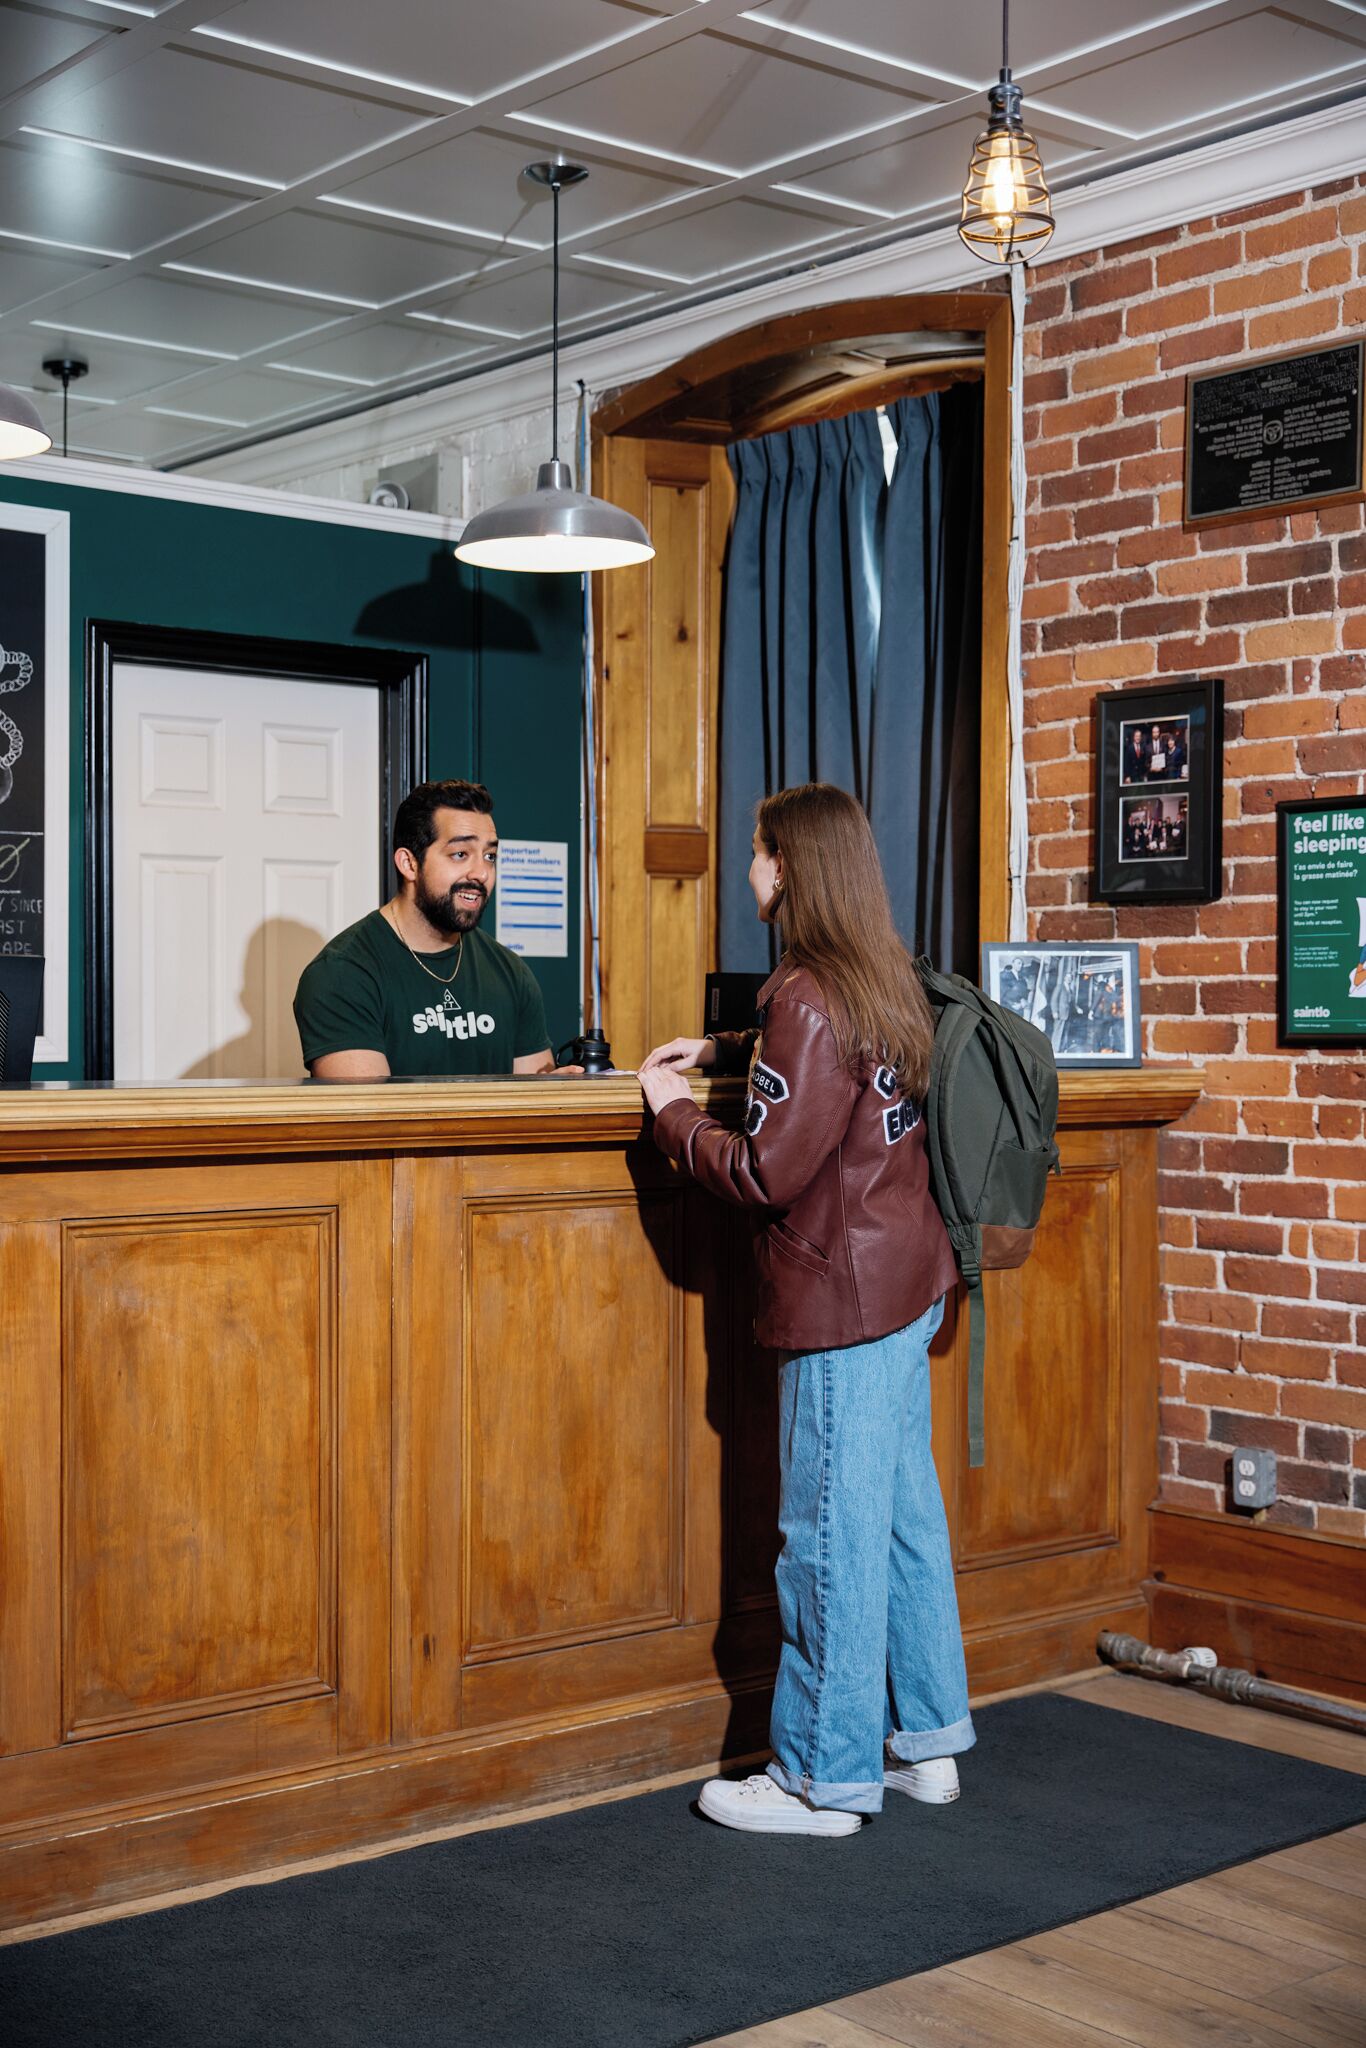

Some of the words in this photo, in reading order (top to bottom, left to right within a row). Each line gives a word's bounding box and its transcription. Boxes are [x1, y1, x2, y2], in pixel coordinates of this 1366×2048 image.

[1294, 815, 1328, 834] feel
[1332, 813, 1365, 831] like
[1294, 833, 1366, 856] sleeping
[501, 847, 541, 855] important
[501, 857, 525, 865] phone
[528, 858, 561, 866] numbers
[1308, 862, 1325, 870] envie
[1327, 861, 1335, 869] de
[1337, 860, 1353, 868] faire
[1294, 873, 1300, 881] la
[1301, 873, 1324, 882] grasse
[10, 897, 43, 914] SINCE
[1294, 1006, 1330, 1017] saintlo
[412, 1004, 496, 1040] saintlo
